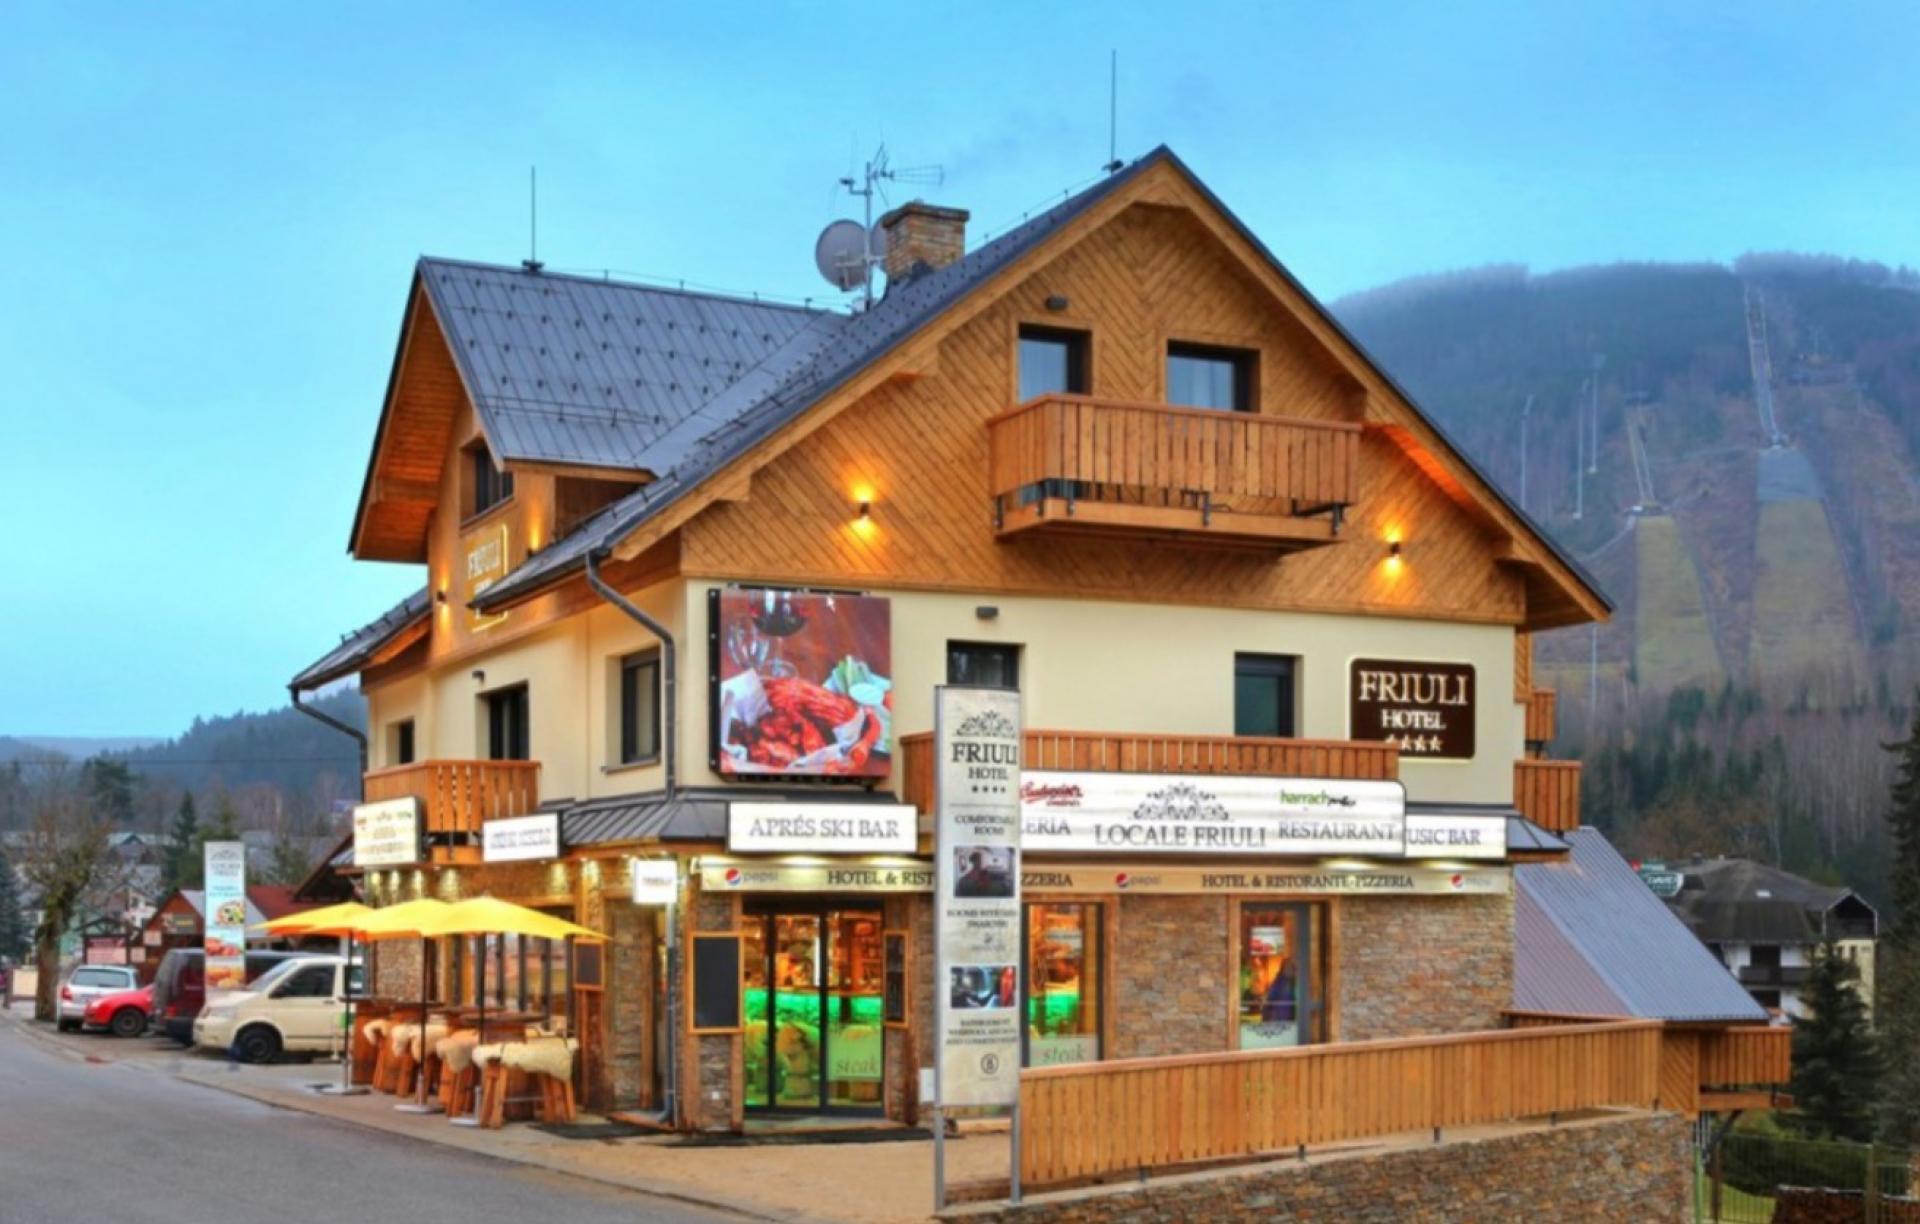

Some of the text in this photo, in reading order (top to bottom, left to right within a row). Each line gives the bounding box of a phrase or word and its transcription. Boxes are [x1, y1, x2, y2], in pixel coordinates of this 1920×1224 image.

[1359, 670, 1468, 706] FRIULI
[1381, 709, 1447, 729] HOTEL
[820, 817, 852, 838] SKI
[858, 819, 900, 839] BAR
[1019, 817, 1072, 834] ERIA
[1279, 821, 1395, 841] RESTAURANT
[1095, 824, 1266, 848] LOCALE FRIULI
[1407, 826, 1481, 846] USIC BAR
[828, 870, 881, 885] HOTEL
[886, 871, 897, 885] &
[1201, 873, 1248, 888] HOTEL
[1252, 874, 1262, 888] &
